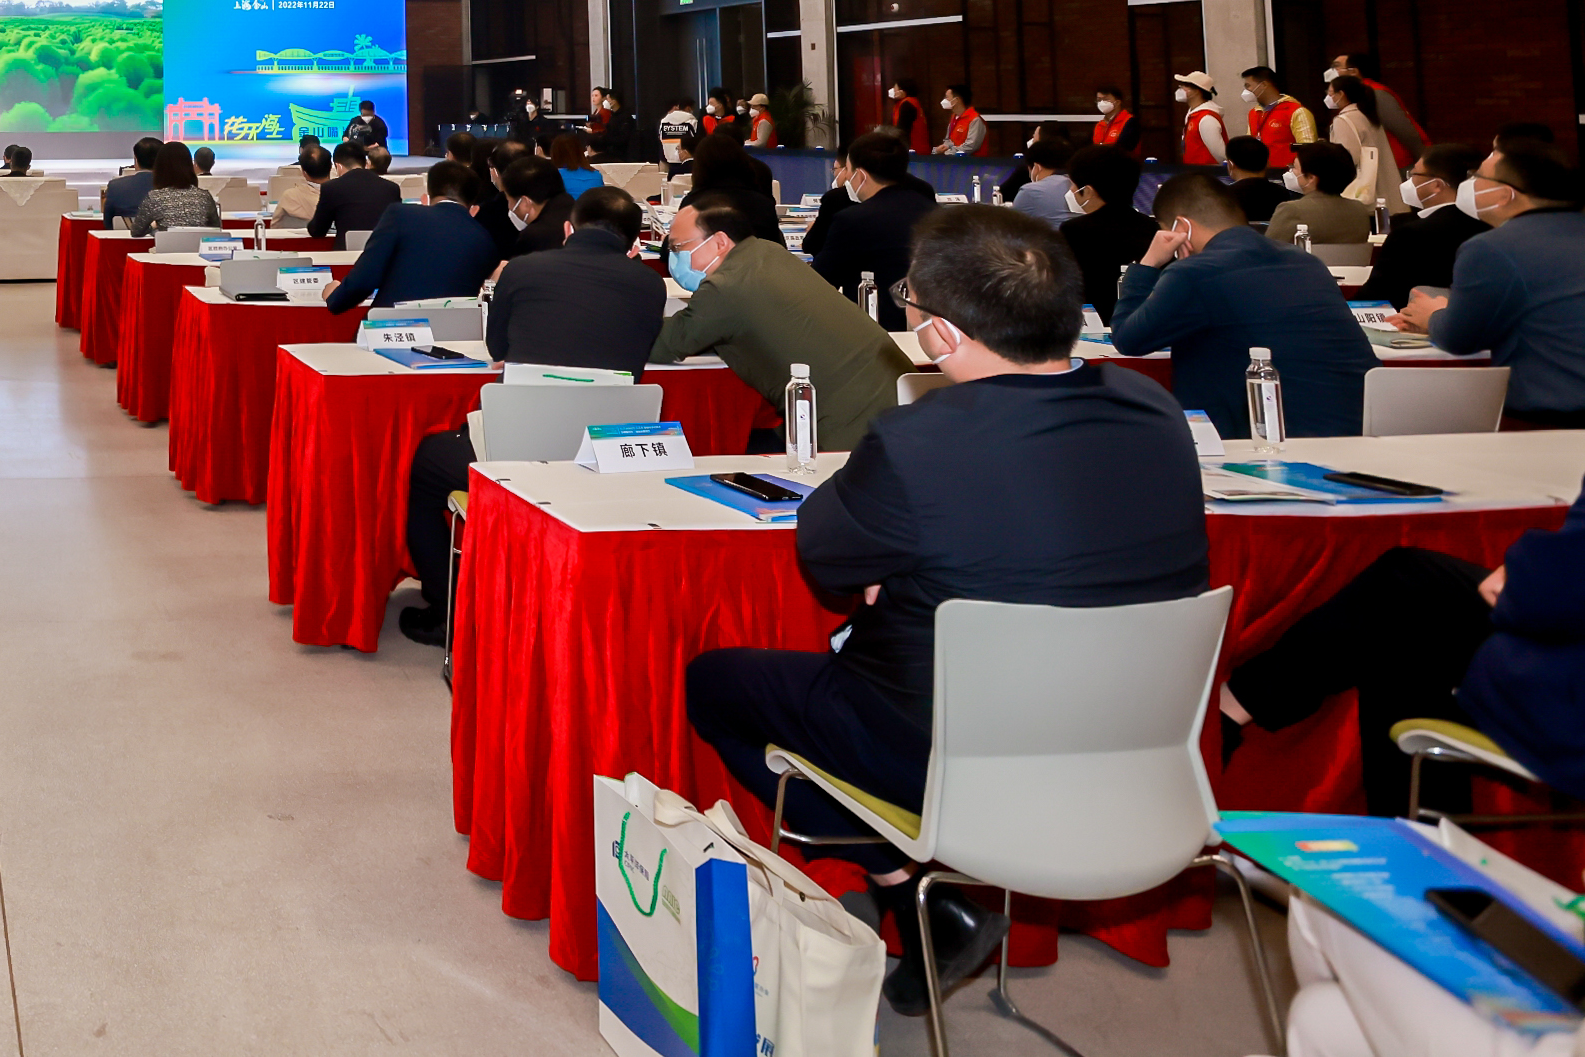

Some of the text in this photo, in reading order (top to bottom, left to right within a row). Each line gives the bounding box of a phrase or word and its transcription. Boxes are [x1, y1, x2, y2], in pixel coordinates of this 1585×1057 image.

[278, 1, 335, 9] 2022年11月22日
[383, 332, 417, 342] 朱泾镇
[619, 442, 669, 459] 廊下镇
